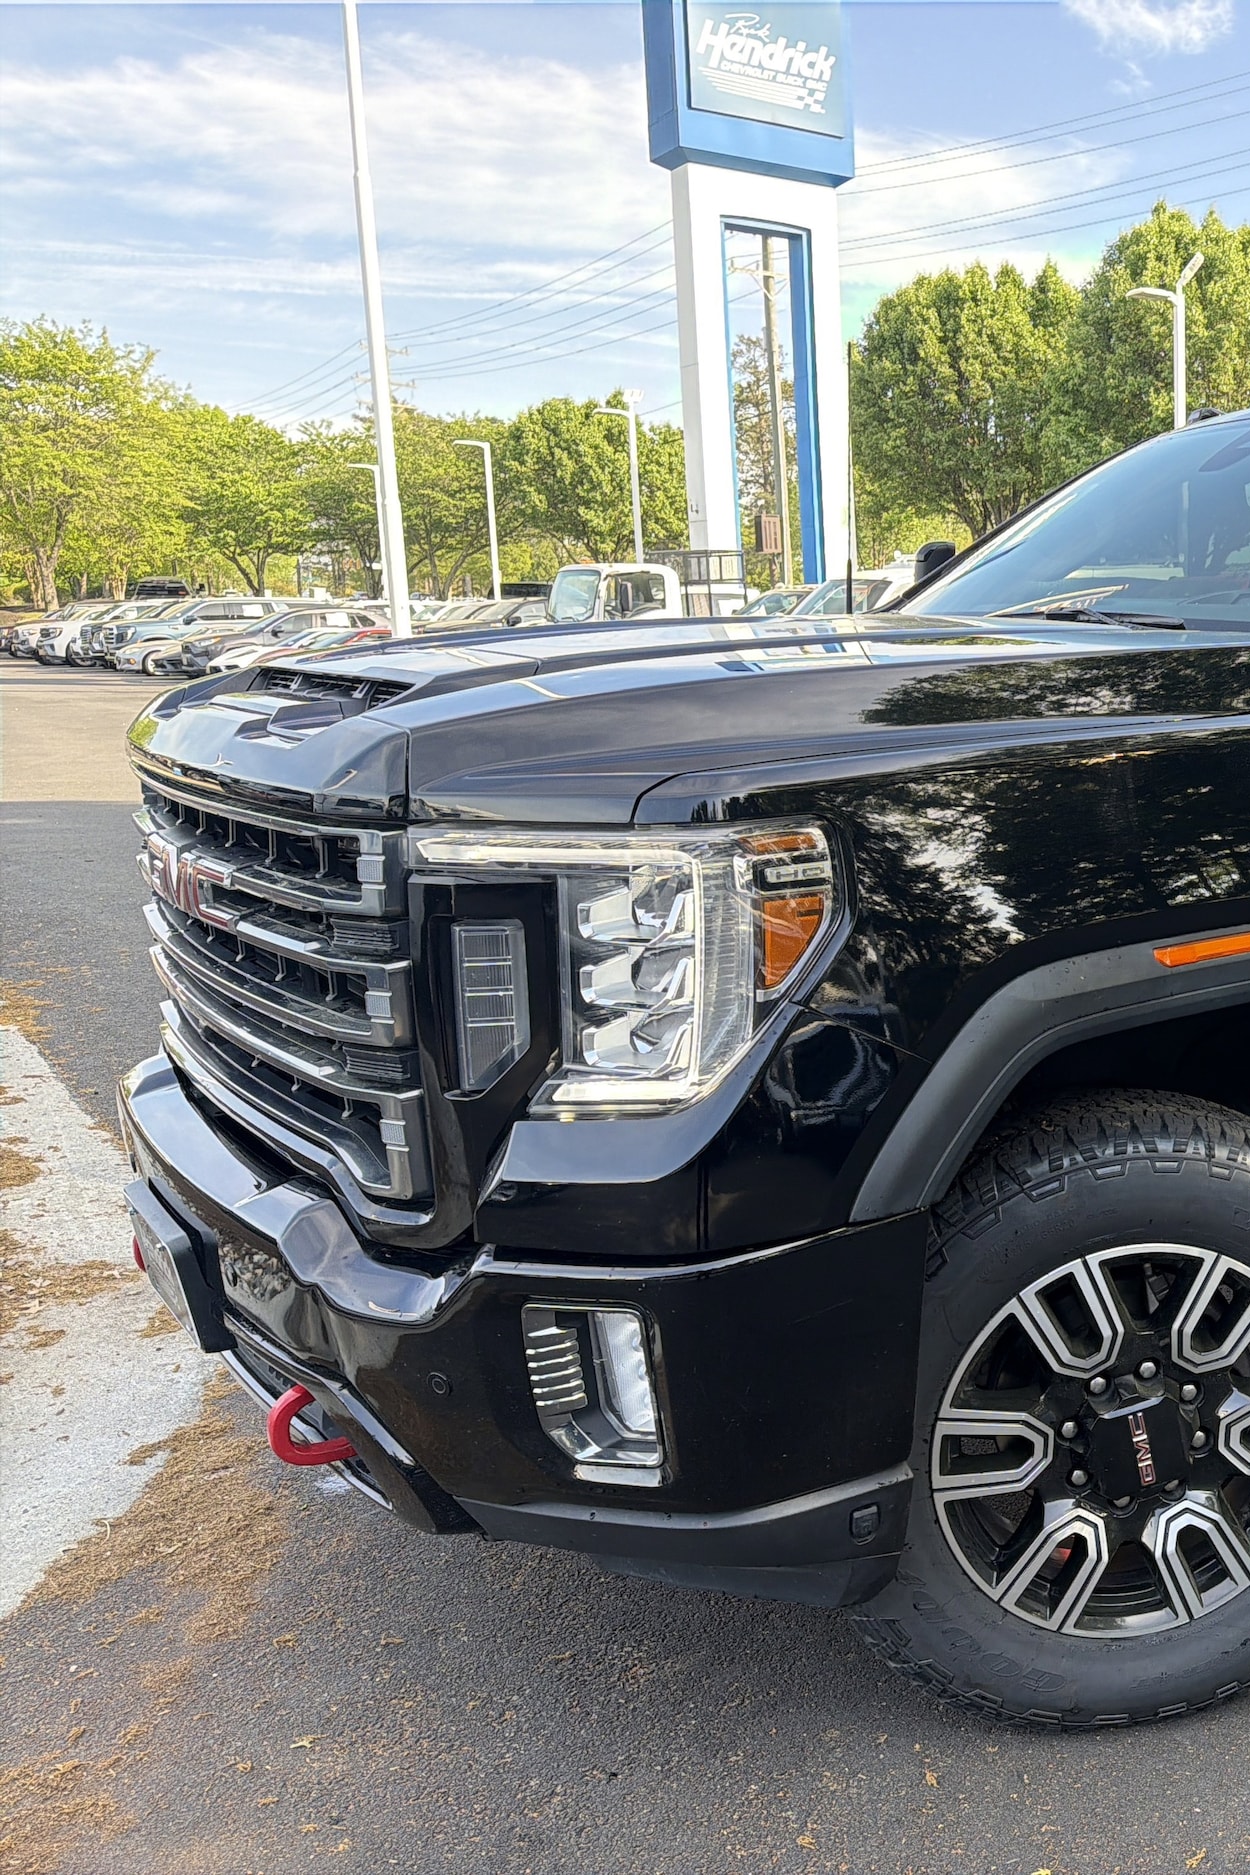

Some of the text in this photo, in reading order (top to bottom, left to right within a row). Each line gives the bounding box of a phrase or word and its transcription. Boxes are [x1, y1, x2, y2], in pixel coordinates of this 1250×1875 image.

[696, 19, 835, 81] Hendrick
[720, 60, 776, 80] CHEVROLET
[776, 73, 804, 87] BUICK
[1128, 1412, 1156, 1486] GMC
